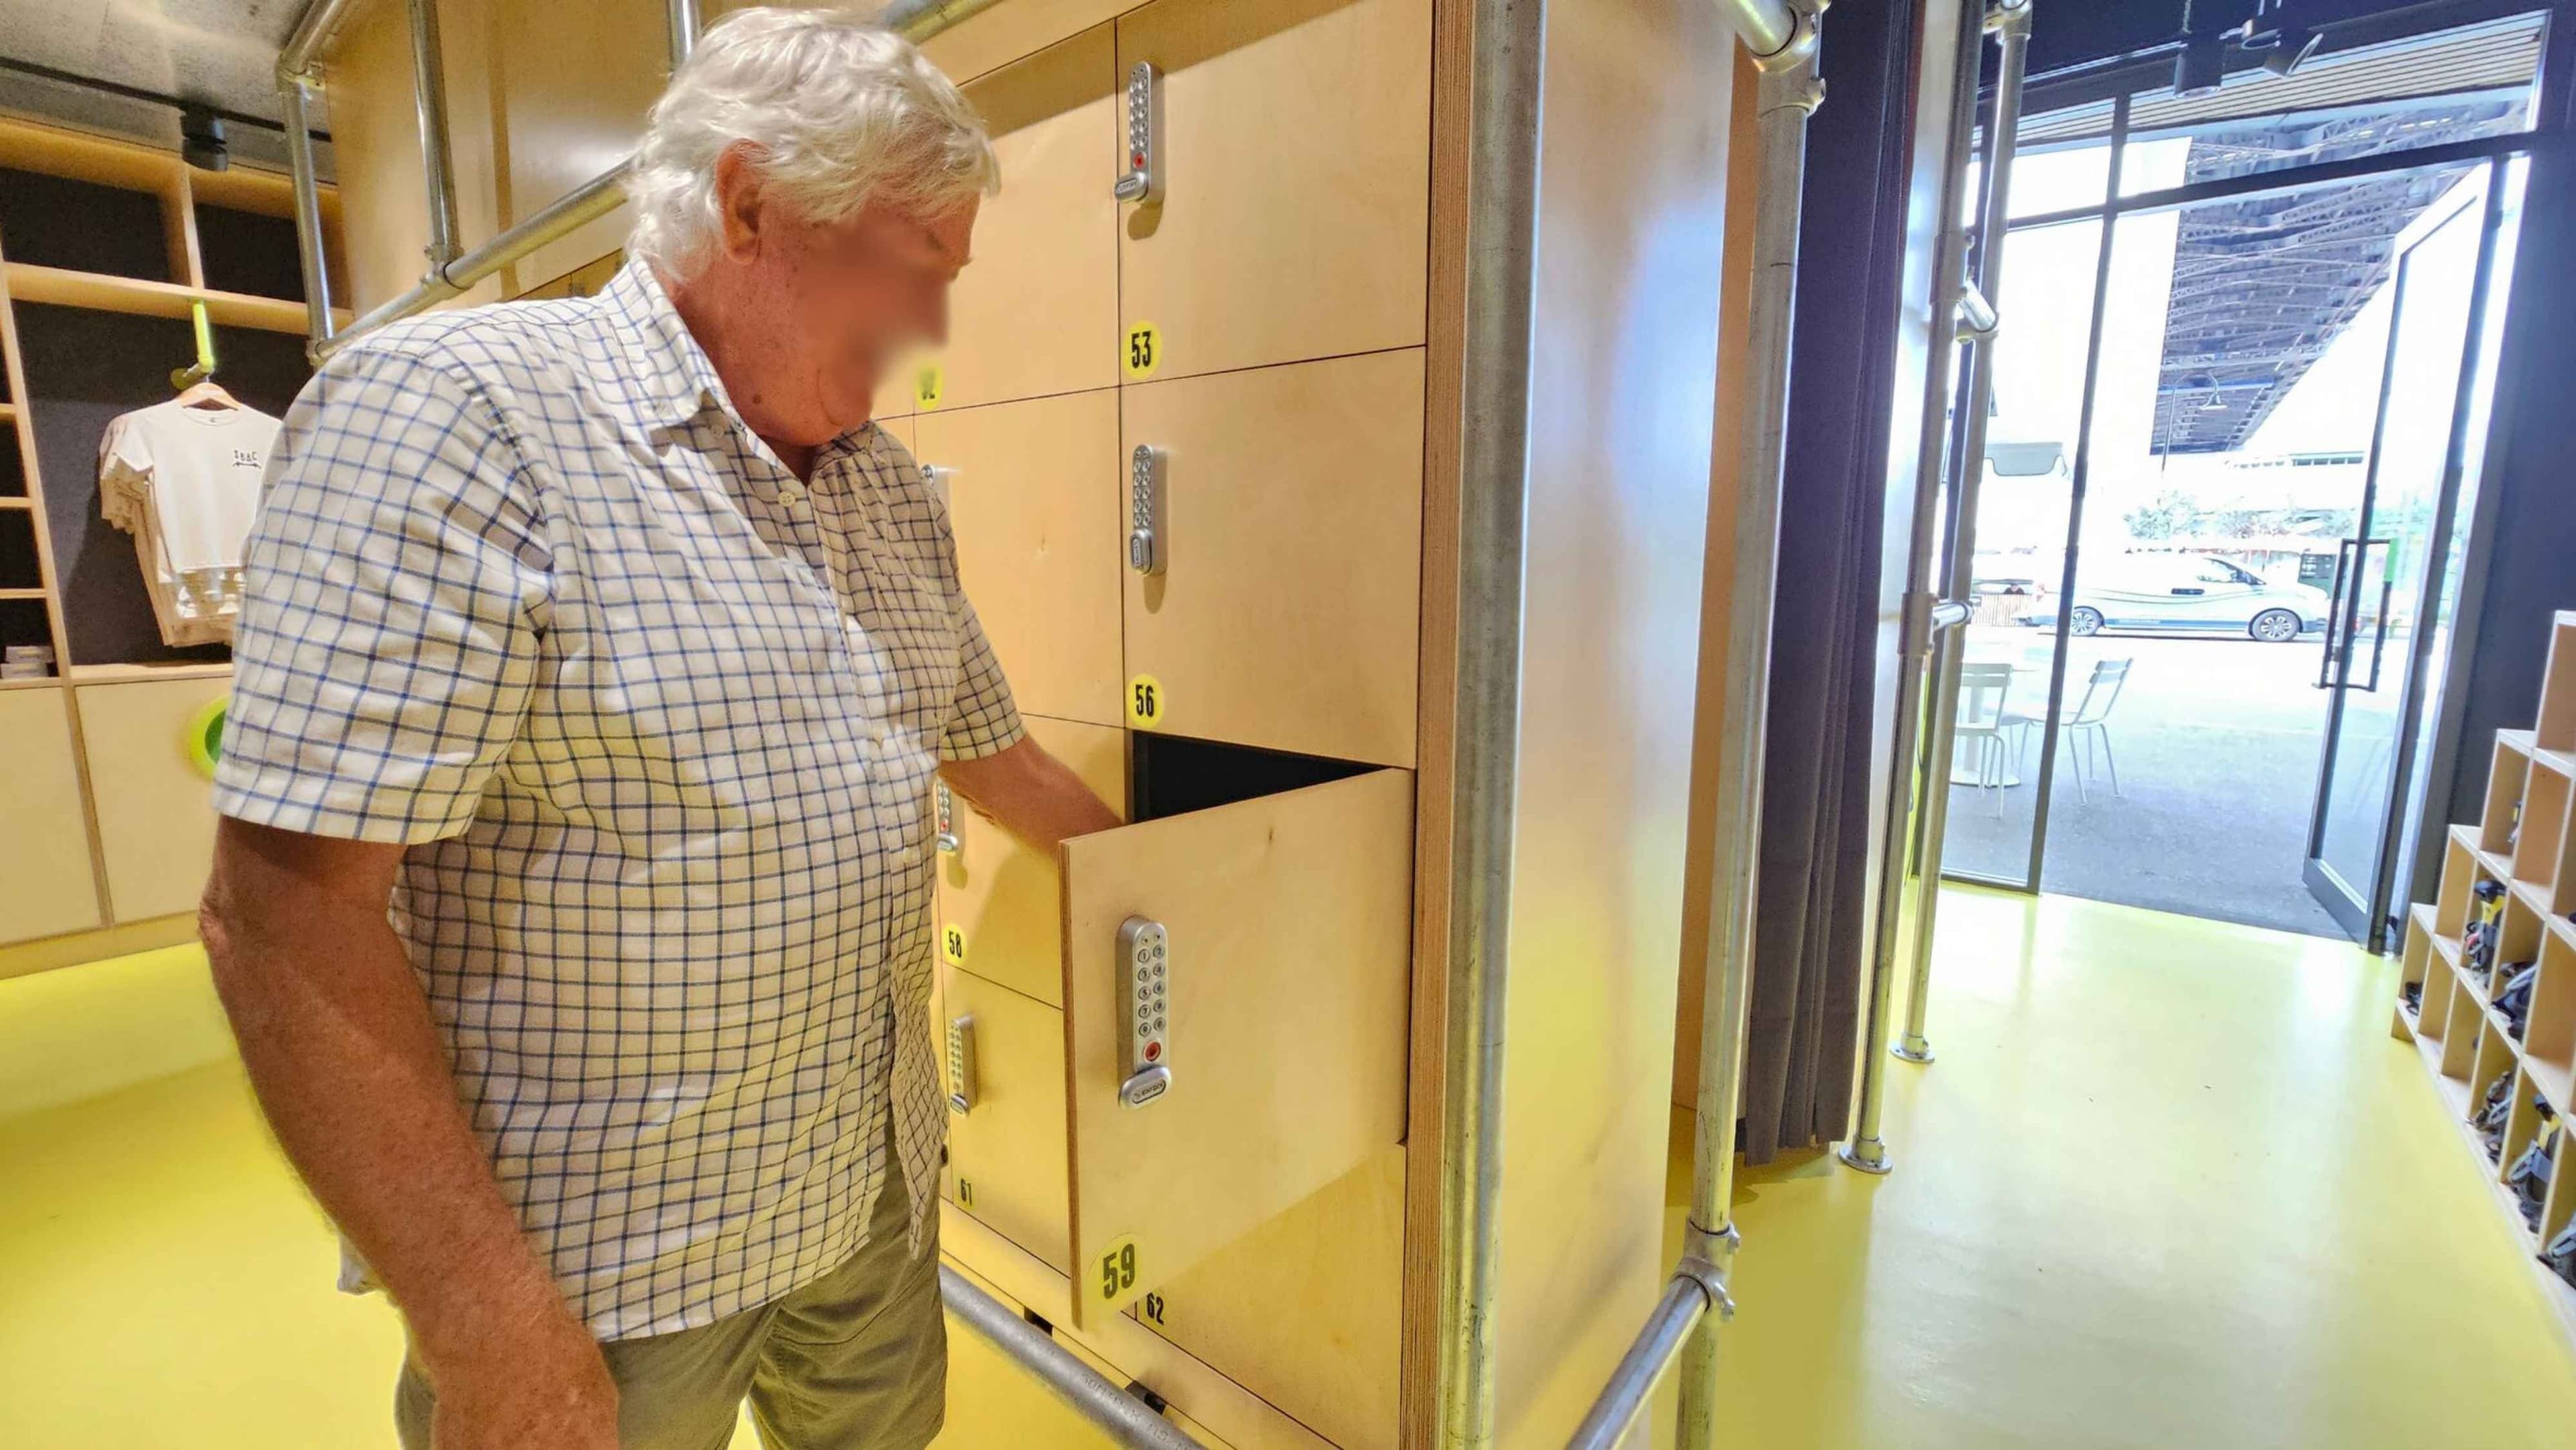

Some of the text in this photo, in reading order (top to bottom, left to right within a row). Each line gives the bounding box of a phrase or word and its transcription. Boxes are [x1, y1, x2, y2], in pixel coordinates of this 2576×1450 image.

[1132, 331, 1151, 368] 53
[1135, 684, 1155, 717] 56
[949, 930, 962, 958] 58
[961, 1178, 972, 1206] 61
[1104, 1244, 1135, 1298] 59
[1147, 1292, 1164, 1325] 62
